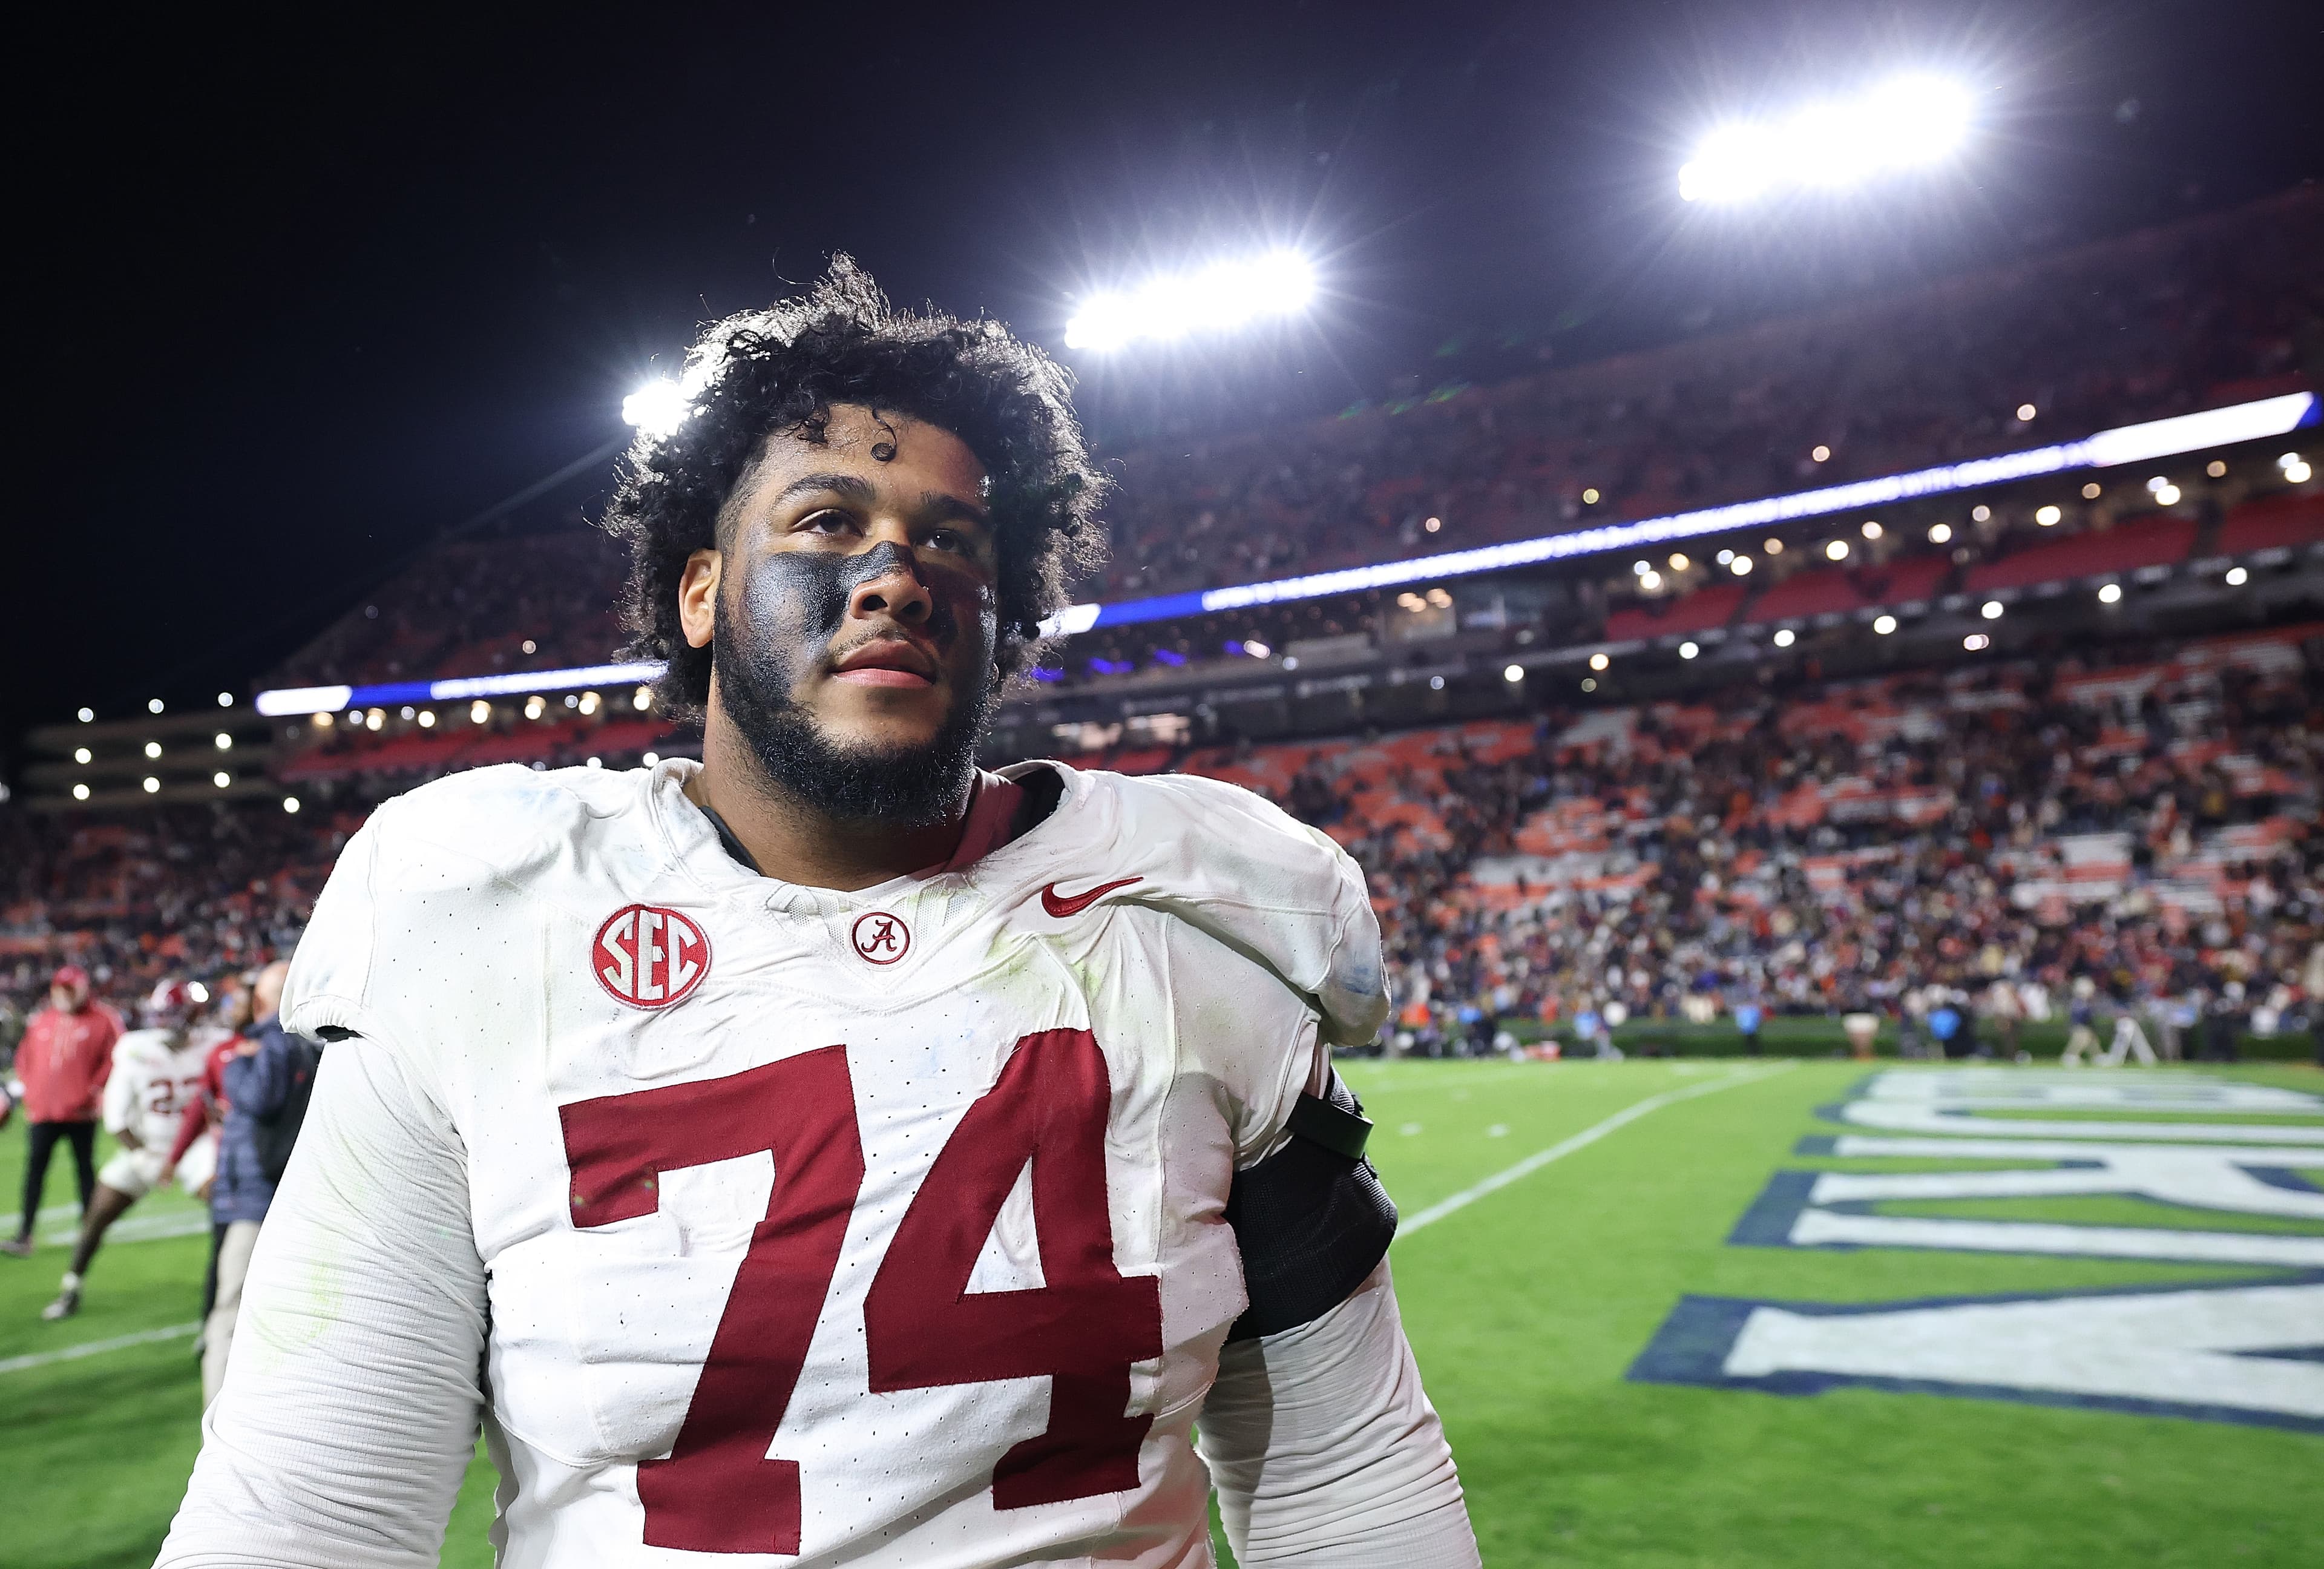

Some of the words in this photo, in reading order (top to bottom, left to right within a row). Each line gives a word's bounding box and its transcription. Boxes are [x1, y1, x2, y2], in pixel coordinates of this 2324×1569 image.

[600, 909, 699, 1000] SEC
[861, 919, 898, 953] A
[558, 1027, 1164, 1556] 74
